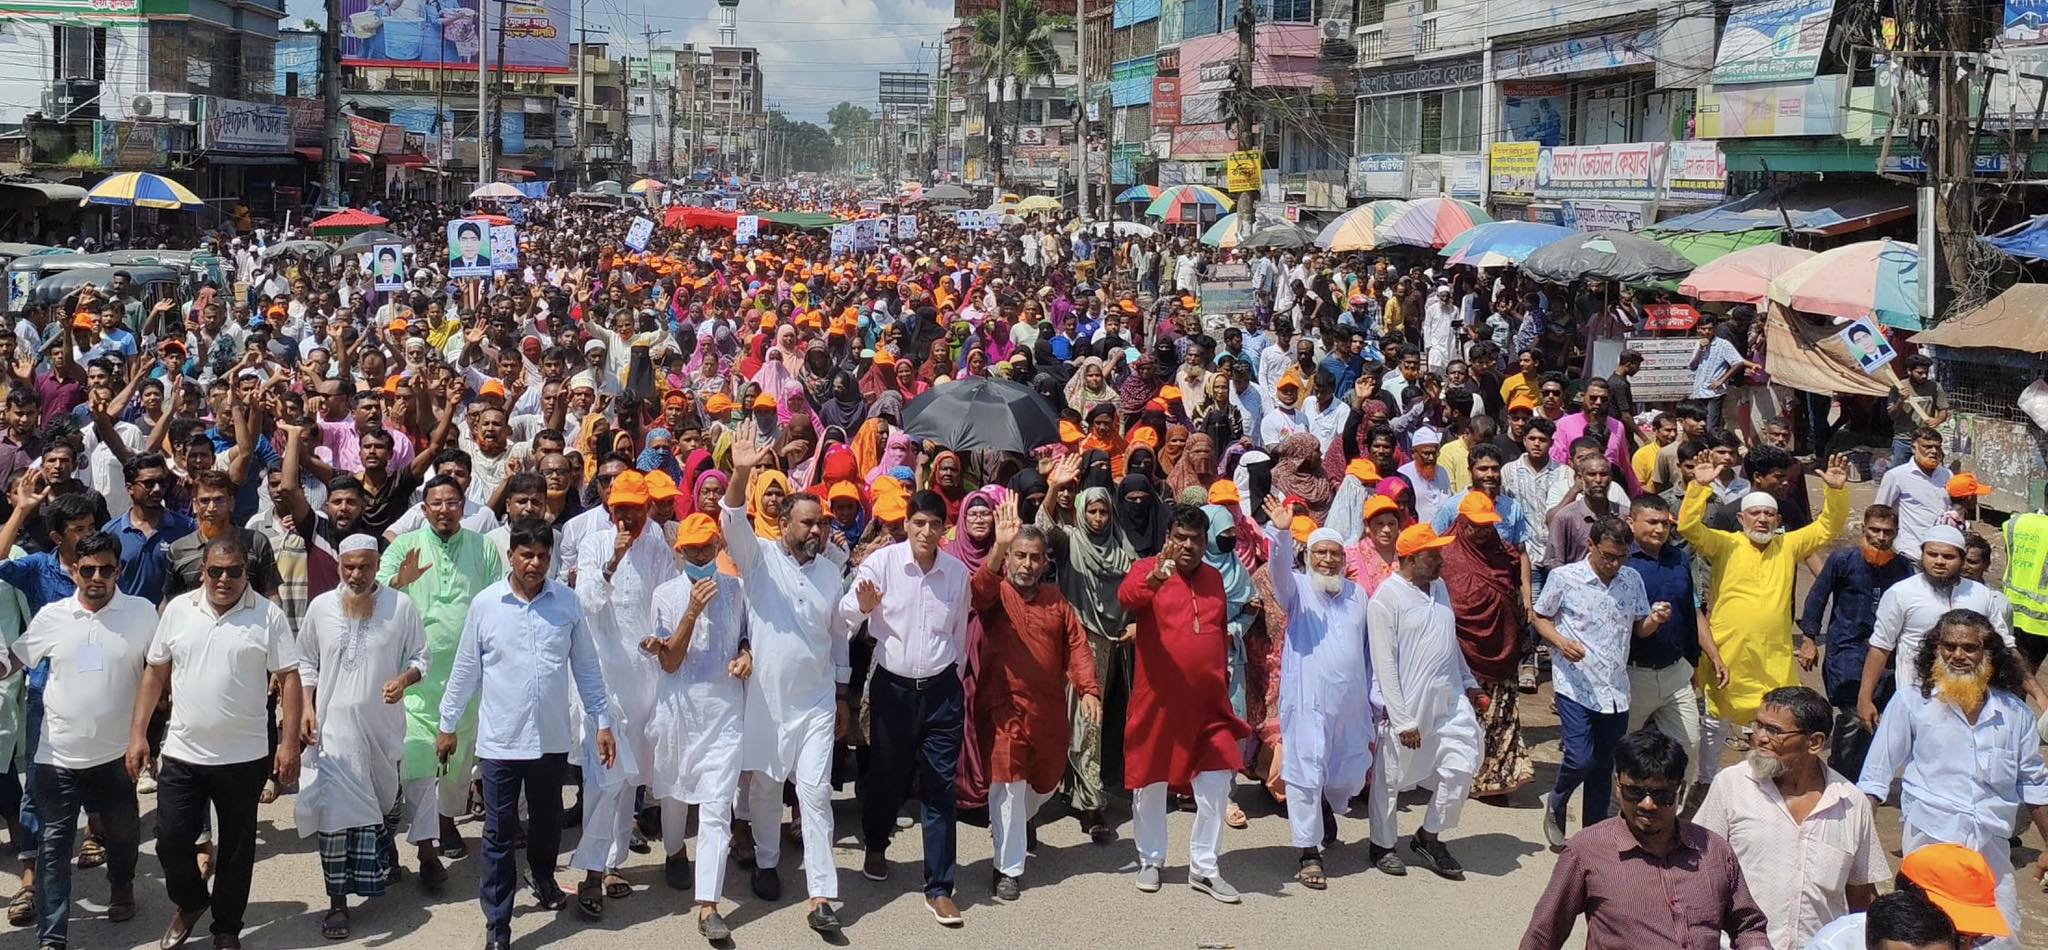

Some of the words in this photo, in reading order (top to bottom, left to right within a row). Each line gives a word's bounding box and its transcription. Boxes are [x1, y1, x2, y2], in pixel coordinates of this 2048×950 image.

[1393, 64, 1442, 89] আবাসিক
[222, 106, 249, 135] হোটেল
[250, 106, 281, 135] পাঁচতারা
[1615, 151, 1648, 176] কেয়ার
[1597, 204, 1627, 225] মেডিকেল
